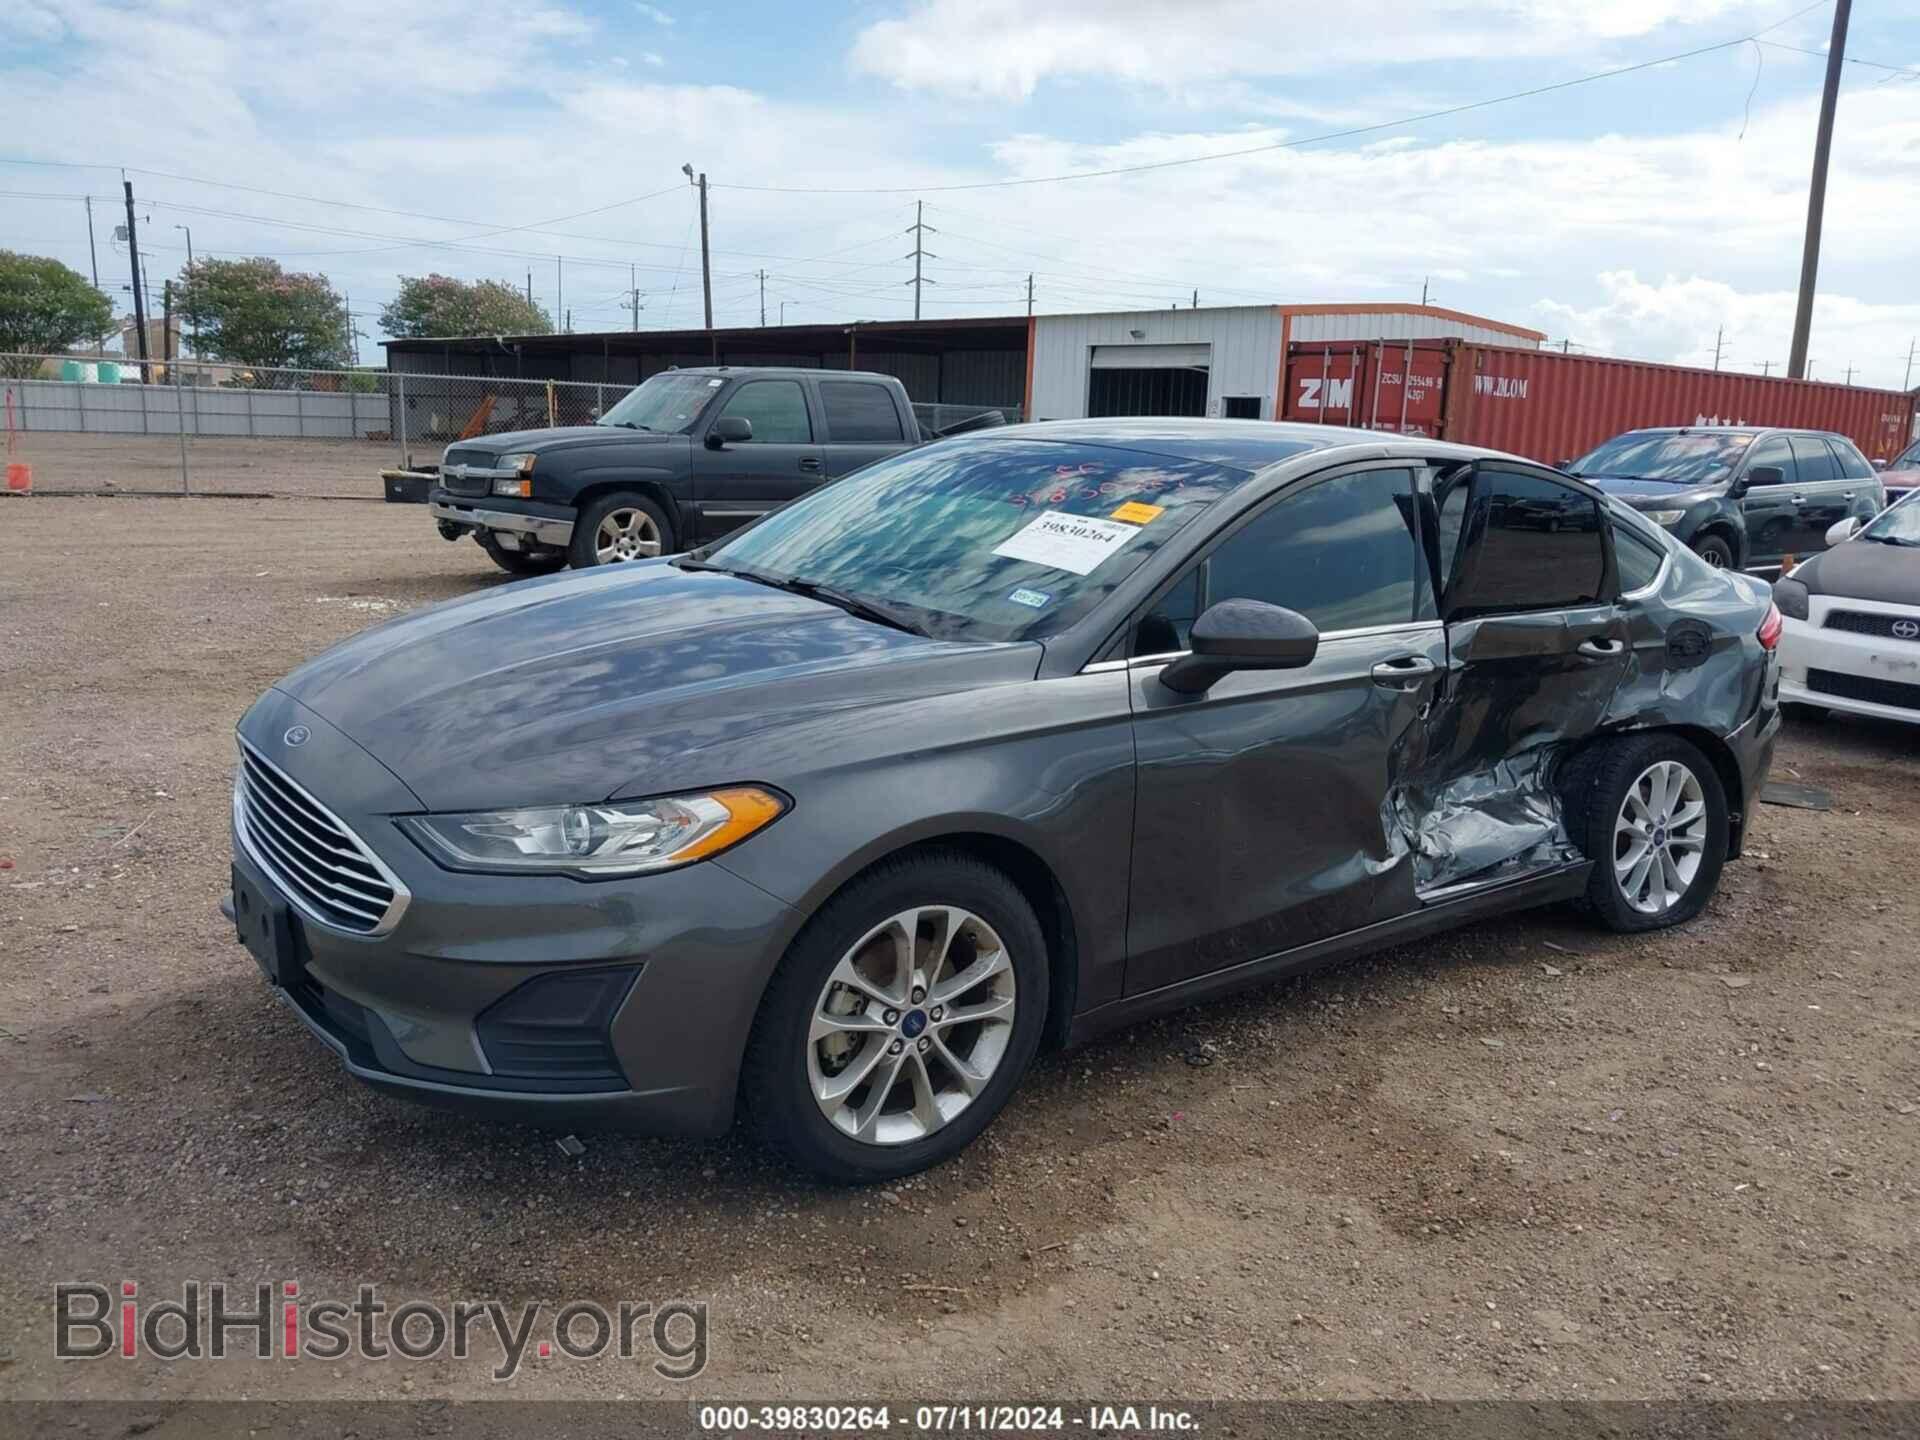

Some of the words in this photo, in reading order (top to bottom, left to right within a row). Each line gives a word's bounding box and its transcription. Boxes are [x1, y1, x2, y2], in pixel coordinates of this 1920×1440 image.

[1381, 372, 1402, 384] ZCSU
[1298, 378, 1354, 409] ZIM
[1042, 521, 1116, 543] 39830264
